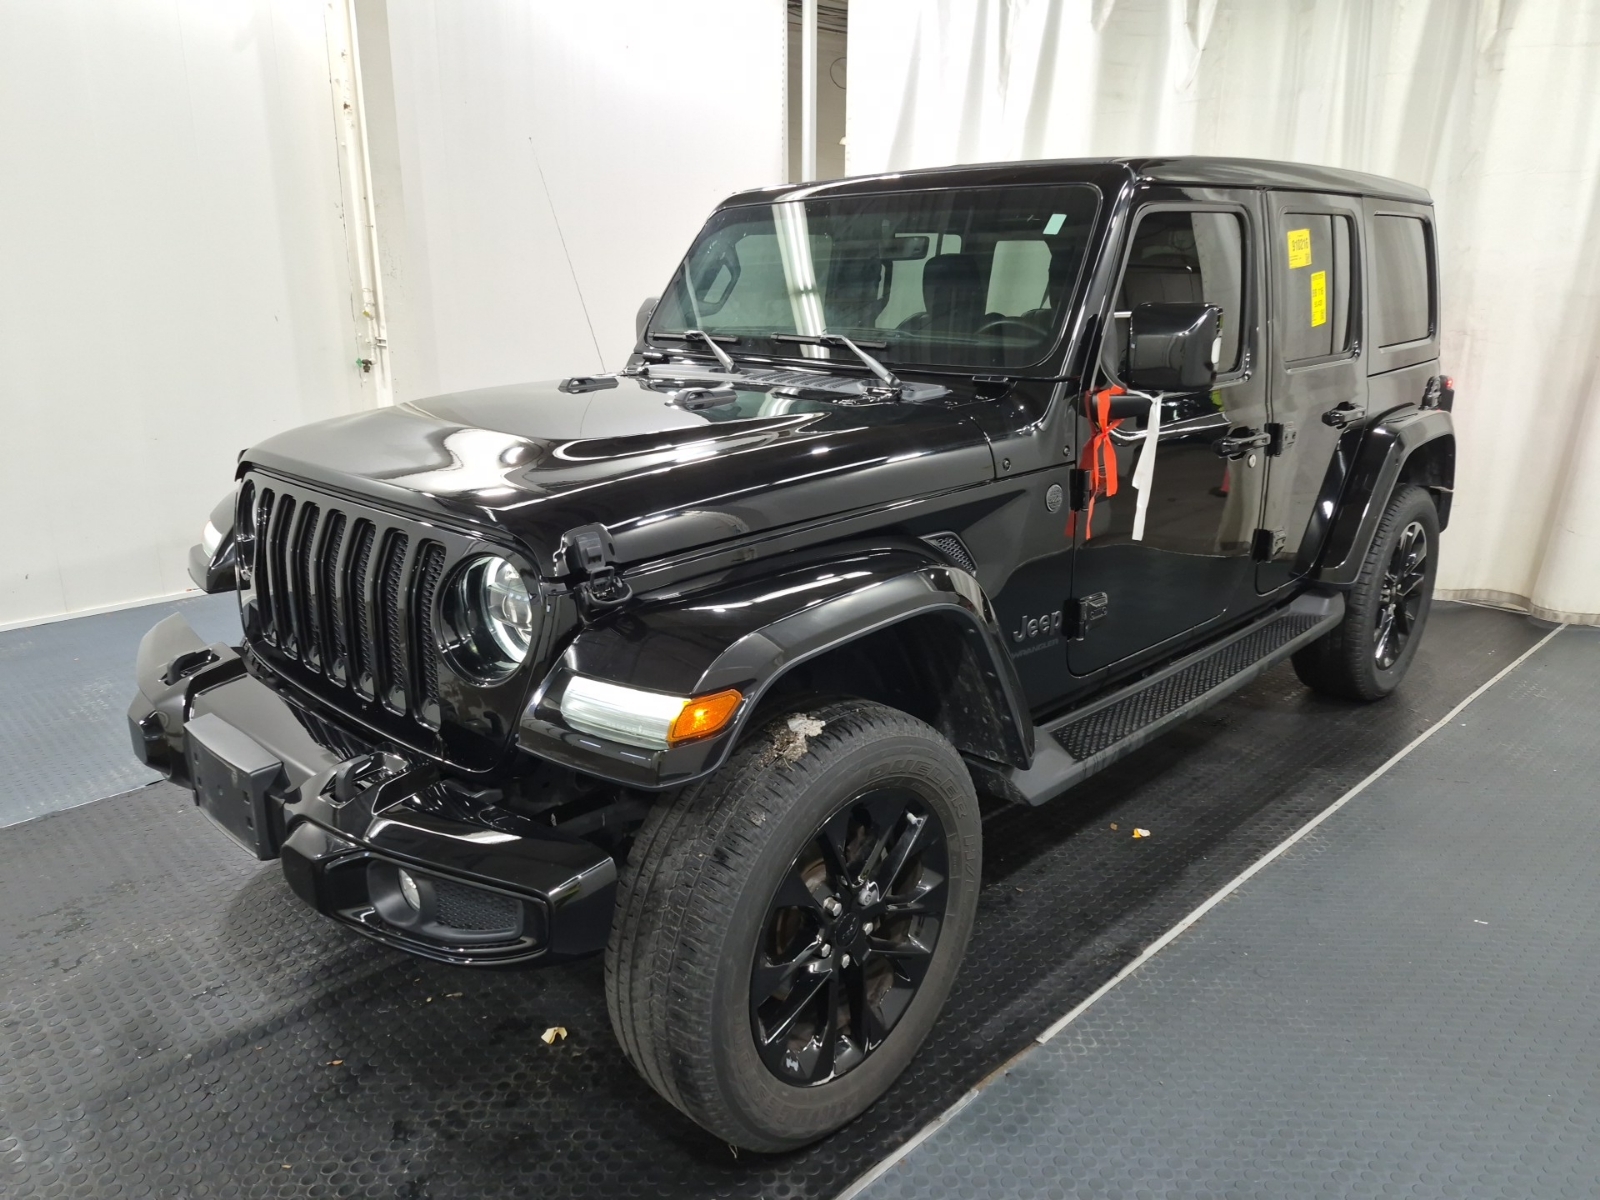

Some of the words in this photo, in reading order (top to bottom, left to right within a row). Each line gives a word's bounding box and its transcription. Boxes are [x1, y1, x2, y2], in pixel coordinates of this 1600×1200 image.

[1013, 610, 1061, 642] Jeep
[1011, 638, 1059, 659] WRANGLER
[868, 760, 967, 819] DUELER
